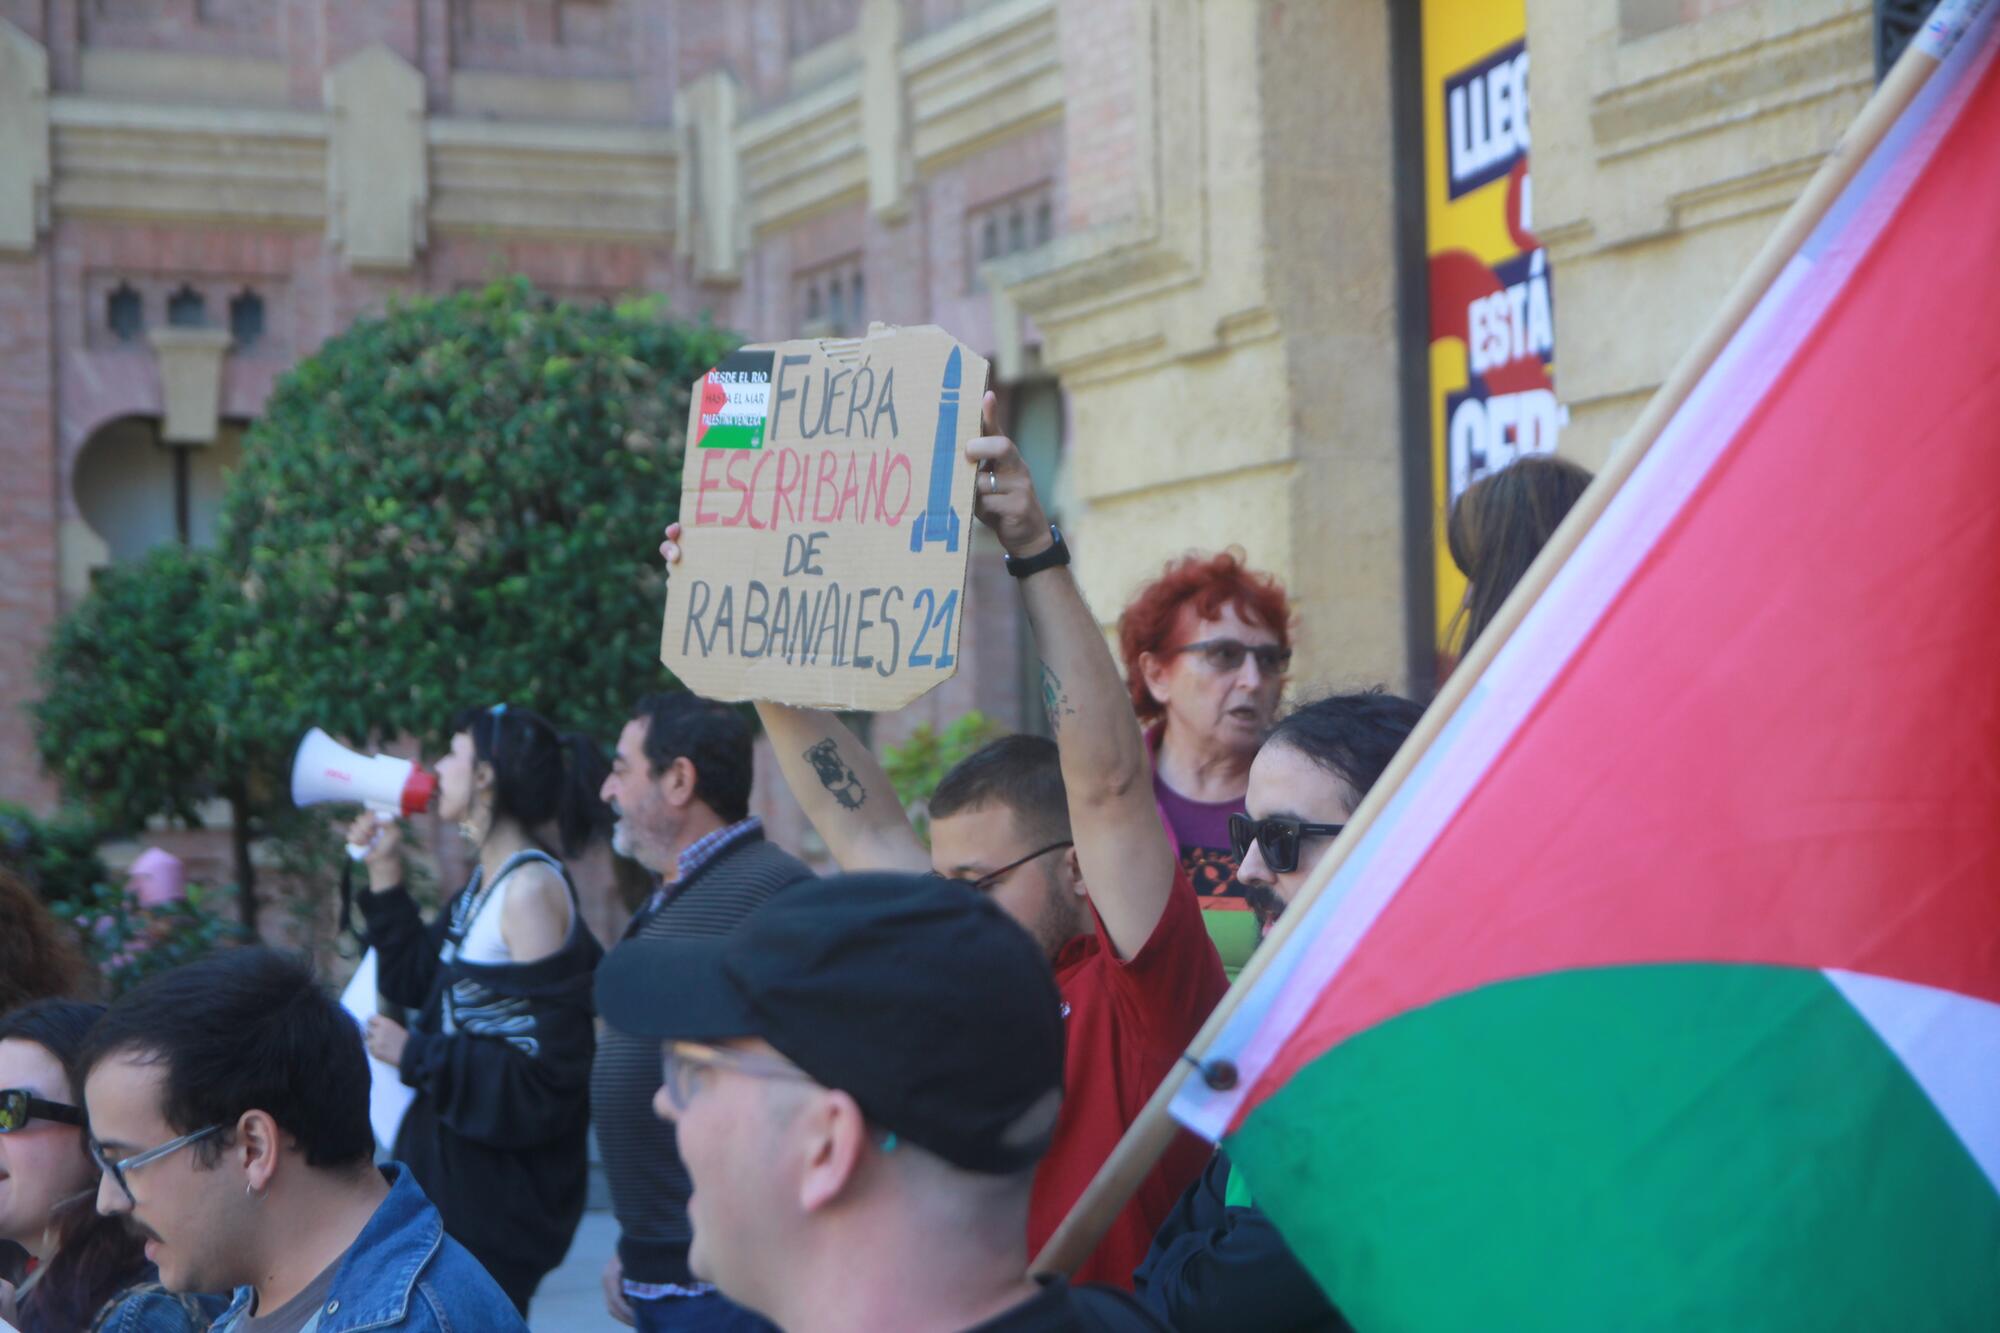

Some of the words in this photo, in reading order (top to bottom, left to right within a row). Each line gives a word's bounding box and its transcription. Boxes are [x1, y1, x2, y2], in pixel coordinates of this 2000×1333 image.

[1468, 248, 1553, 375] ESTÁ
[705, 391, 731, 405] HASTA
[734, 391, 743, 405] EL
[745, 391, 765, 405] MAR
[708, 371, 737, 384] DESDE
[739, 371, 749, 384] EL
[771, 355, 899, 441] FUERA
[695, 447, 912, 530] ESCRIBANO
[782, 530, 830, 577] DE
[681, 580, 904, 677] RABANALES
[908, 587, 959, 669] 21
